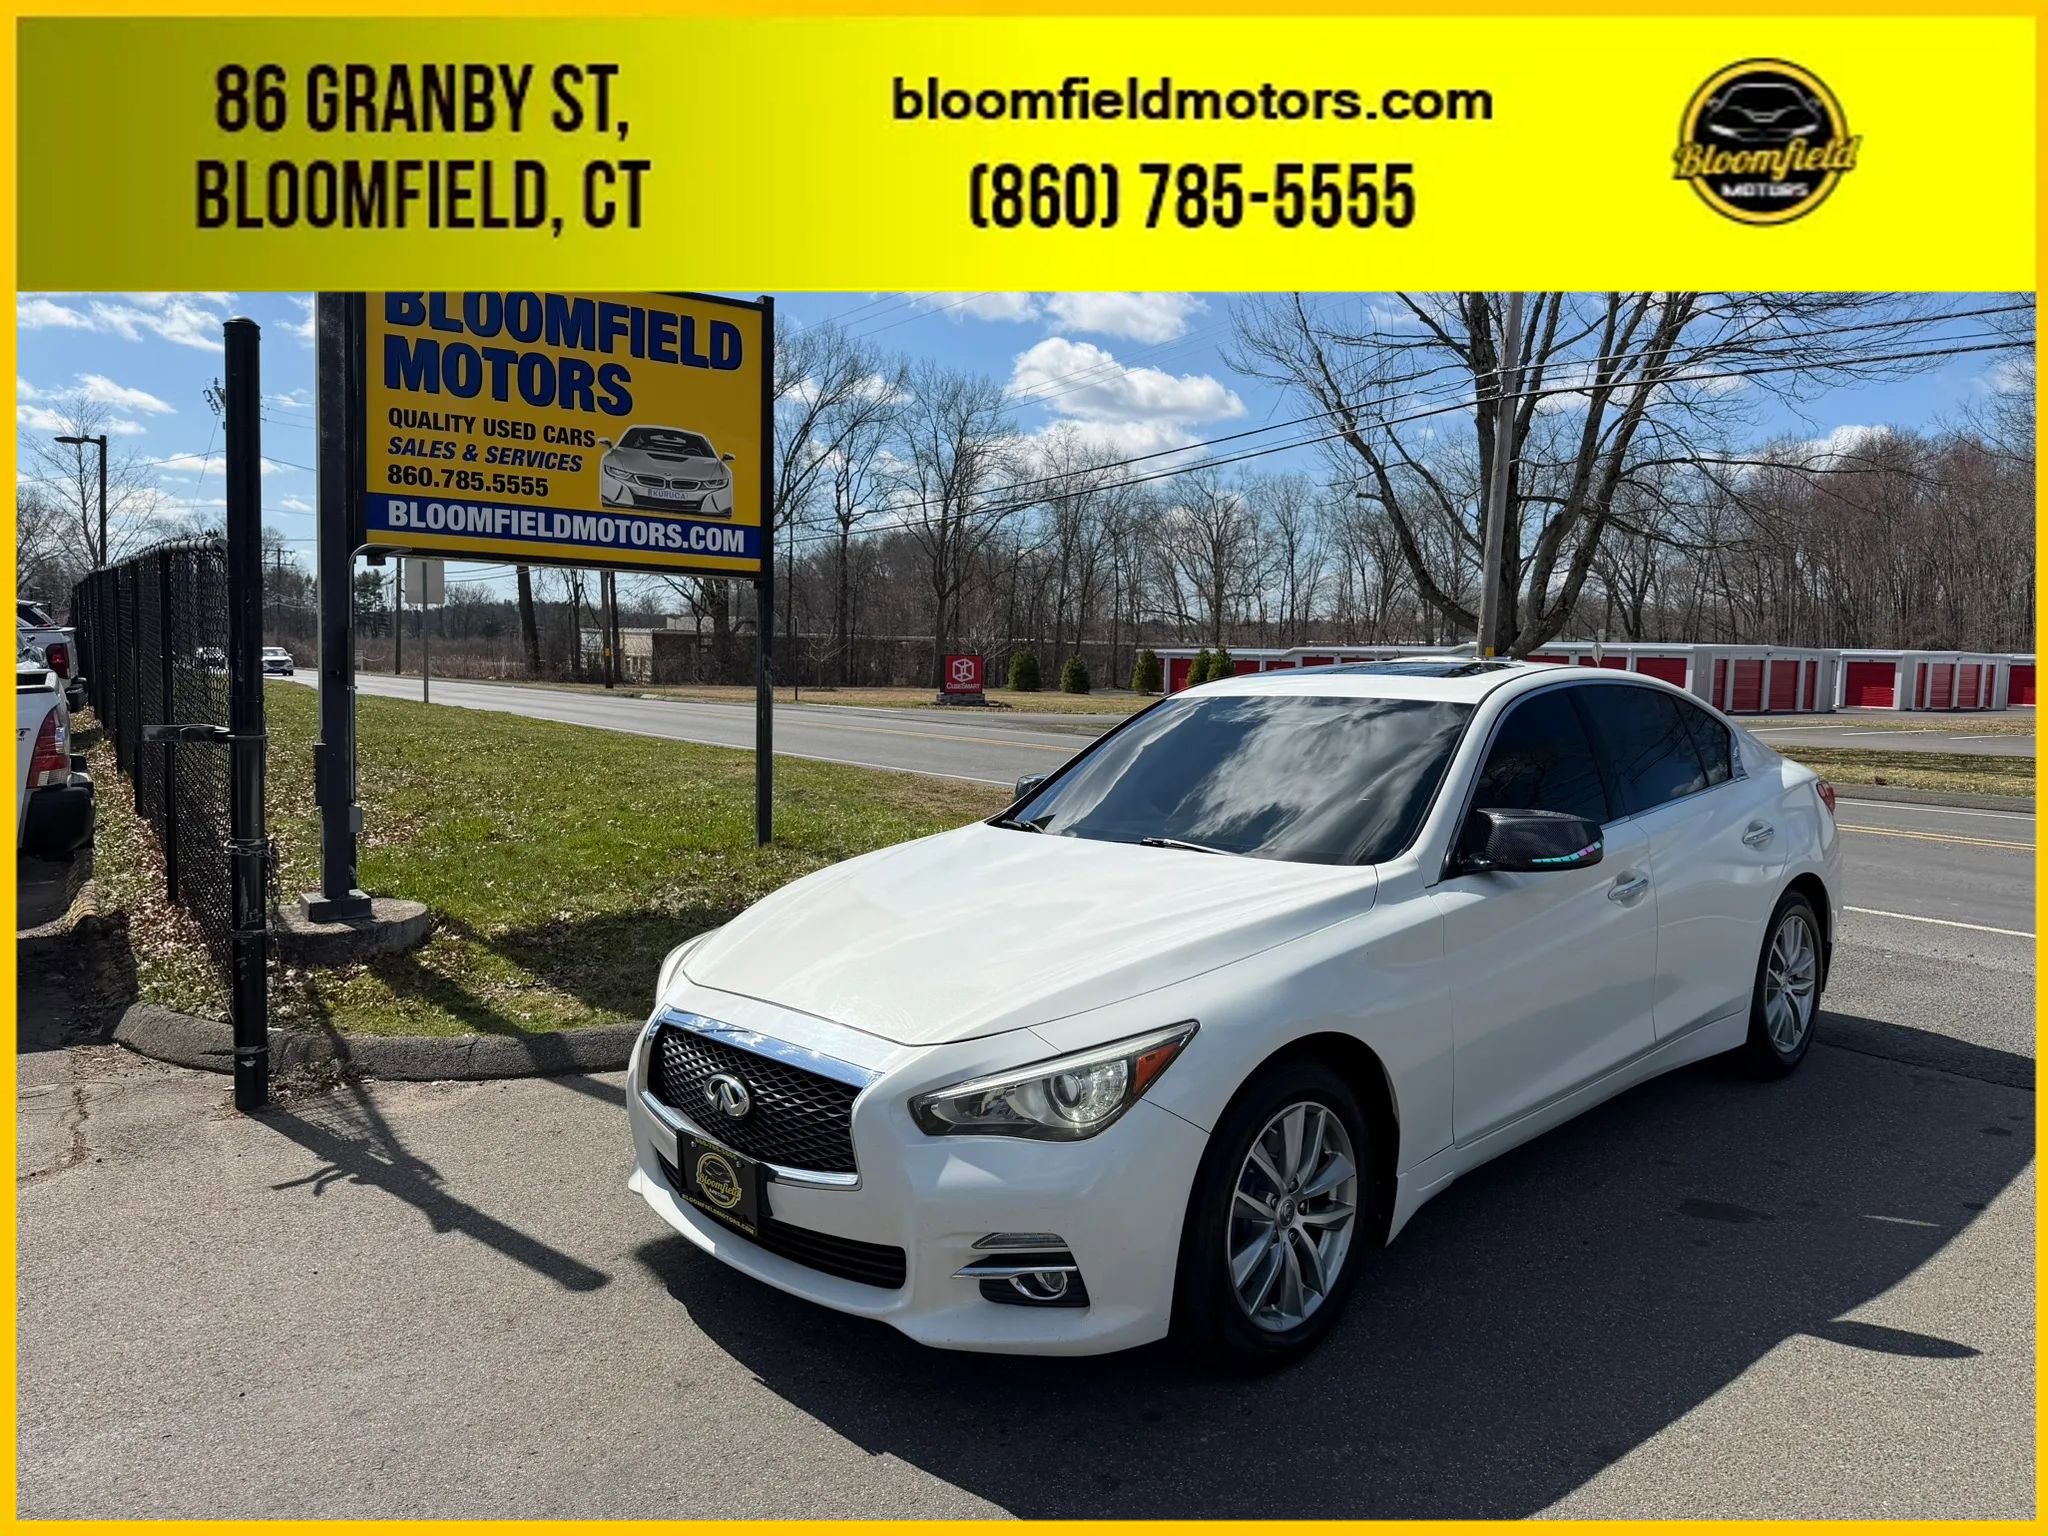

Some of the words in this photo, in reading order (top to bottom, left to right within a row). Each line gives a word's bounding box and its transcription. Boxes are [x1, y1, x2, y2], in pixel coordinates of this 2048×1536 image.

[384, 291, 743, 370] BLOOMFIELD
[384, 334, 633, 417] MOTORS
[388, 407, 477, 434] QUALITY
[483, 417, 537, 441] USED
[543, 425, 596, 448] CARS
[387, 436, 457, 460] SALES
[462, 444, 479, 463] &
[485, 446, 584, 472] SERVICES
[387, 464, 549, 497] 860.785.5555
[388, 500, 745, 553] BLOOMFIELDMOTORS.COM
